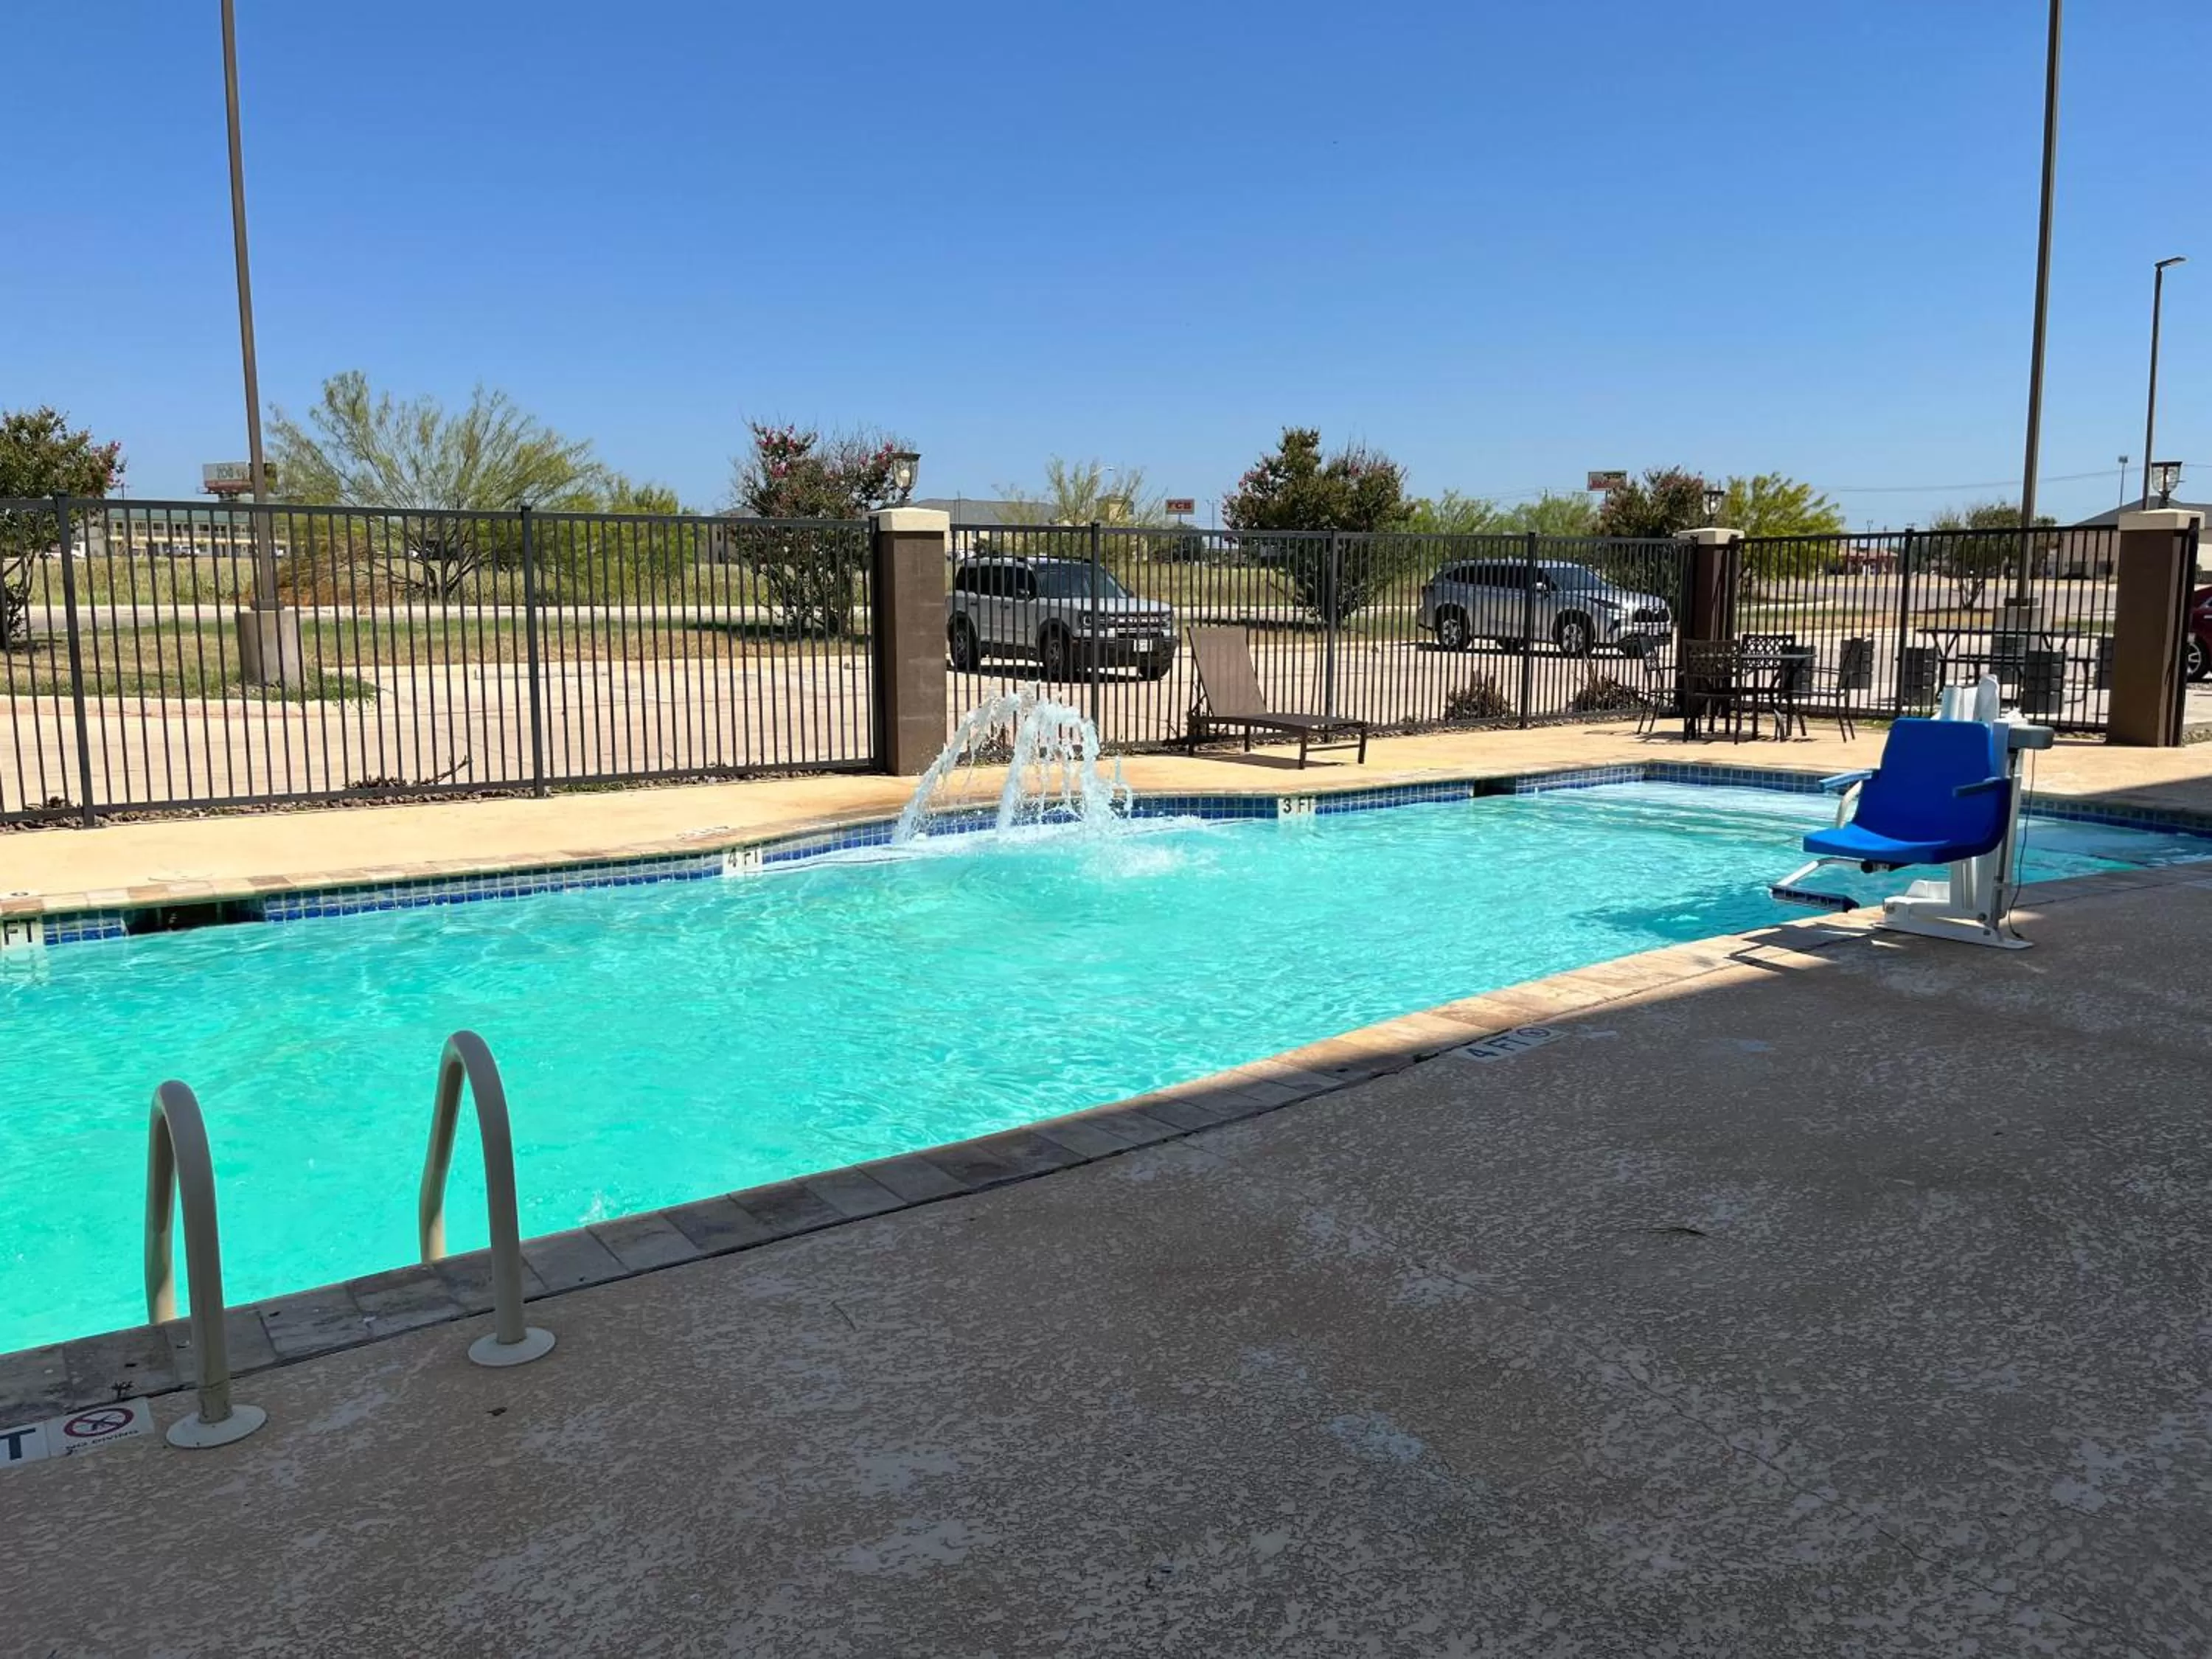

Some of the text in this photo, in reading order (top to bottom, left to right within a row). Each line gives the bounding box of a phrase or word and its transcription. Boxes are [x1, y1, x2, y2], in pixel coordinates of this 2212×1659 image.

[1283, 796, 1312, 814] 3 FT
[728, 843, 760, 868] 4 FT
[3, 917, 38, 946] FT
[1466, 1036, 1531, 1058] 4 FT
[0, 1427, 36, 1461] T
